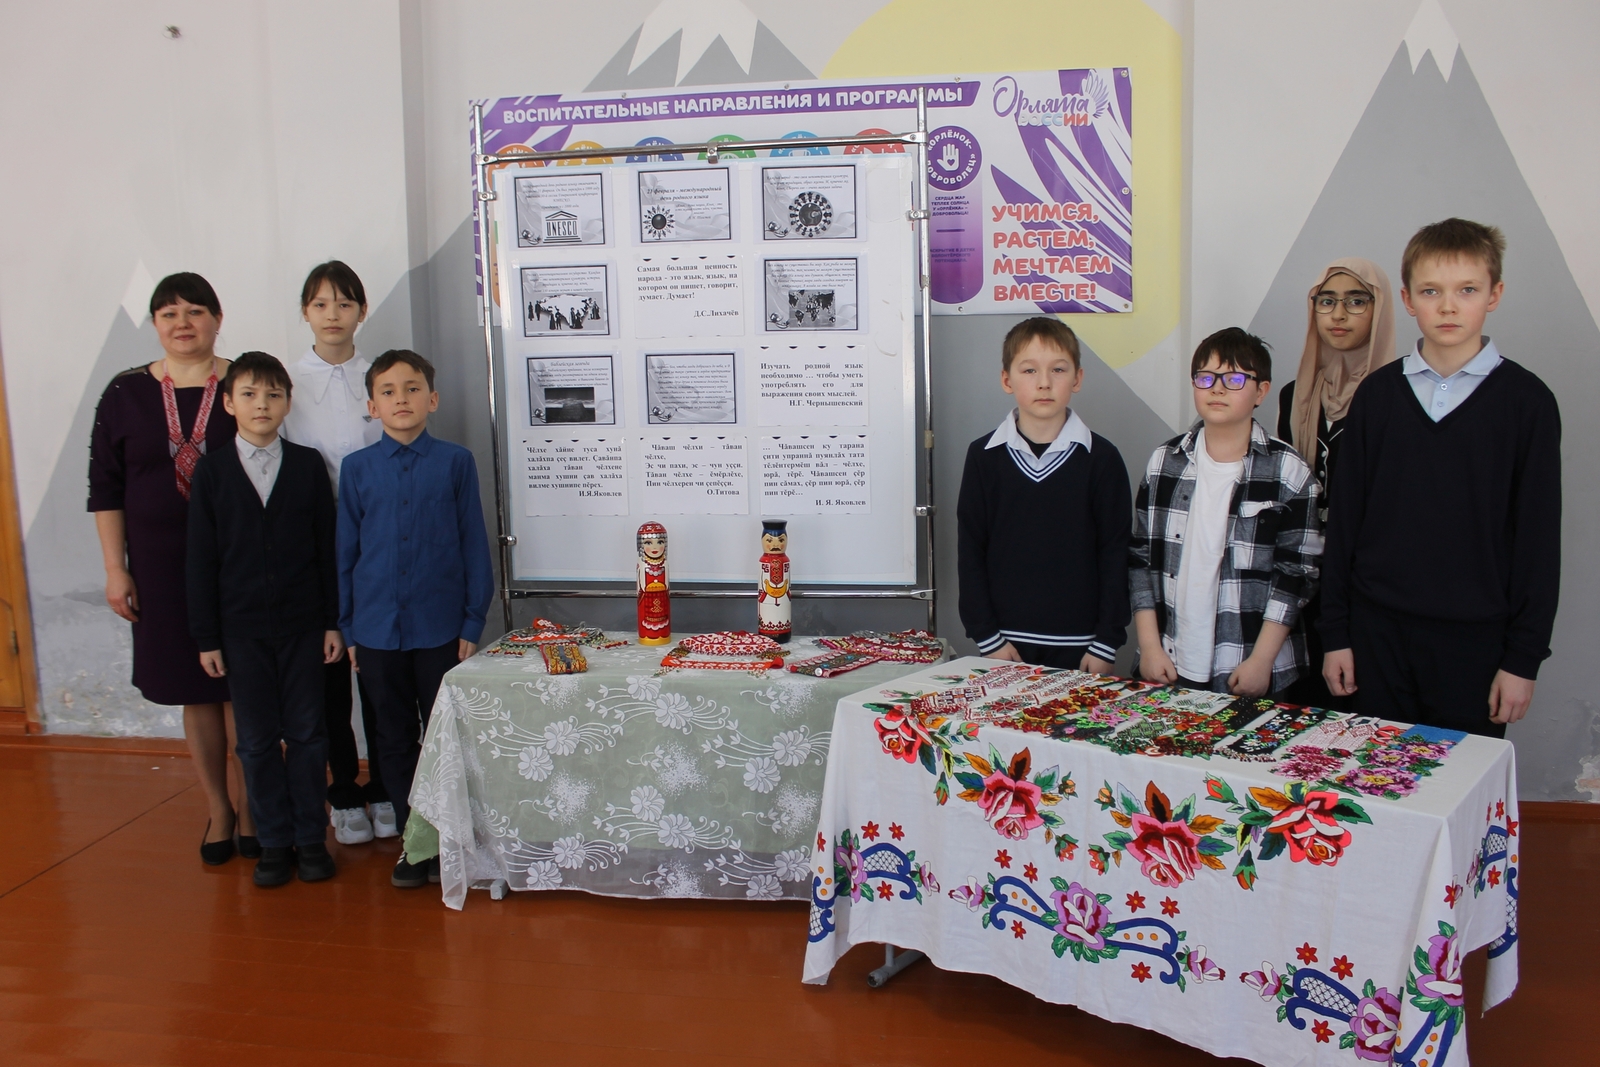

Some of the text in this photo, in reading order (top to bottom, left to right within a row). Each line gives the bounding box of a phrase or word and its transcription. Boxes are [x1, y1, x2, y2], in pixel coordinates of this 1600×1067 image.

[992, 75, 1090, 118] Орлята
[503, 101, 670, 124] ВОСПИТАТЕЛЬНЫЕ
[674, 93, 811, 113] НАПРАВЛЕНИЯ
[817, 92, 831, 107] И
[1018, 113, 1088, 127] РОССИИ
[992, 204, 1099, 222] УЧИМСЯ,
[546, 221, 577, 236] UNESCO
[993, 230, 1094, 249] РАСТЕМ,
[993, 256, 1111, 275] МЕЧТАЕМ
[639, 292, 695, 302] думает. Думает!
[994, 282, 1096, 301] ВМЕСТЕ!
[694, 310, 739, 318] Д.С.Лихачёв
[760, 363, 790, 371] Изучать
[804, 362, 830, 370] родной
